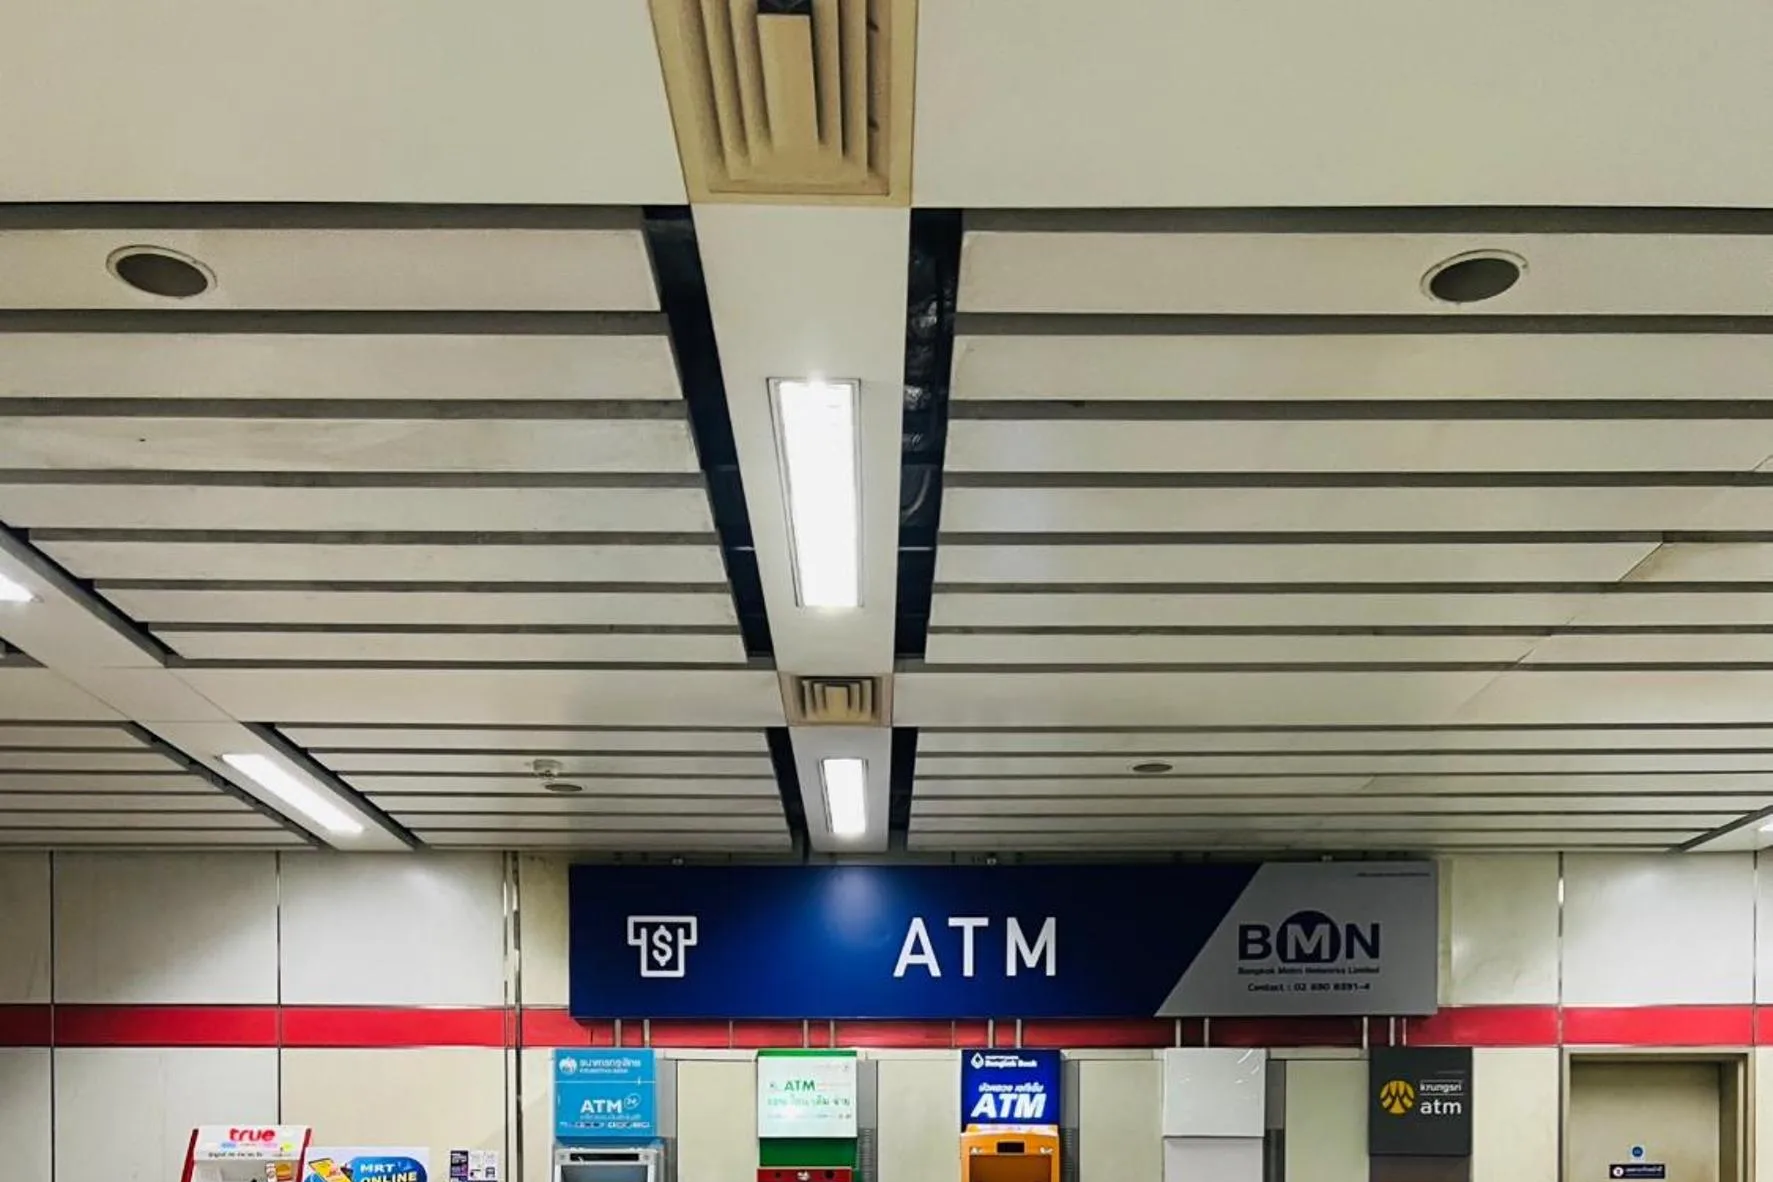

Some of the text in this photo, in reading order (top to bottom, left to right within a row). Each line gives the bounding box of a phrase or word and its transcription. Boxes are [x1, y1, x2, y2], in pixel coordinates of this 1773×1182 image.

[1238, 911, 1380, 963] BMN
[893, 916, 1057, 977] ATM
[1247, 983, 1284, 992] Contact
[784, 1080, 816, 1091] ATM
[1420, 1083, 1462, 1093] krungsri
[580, 1099, 622, 1113] ATM
[970, 1093, 1047, 1118] ATM
[1420, 1099, 1462, 1114] atm
[229, 1128, 275, 1141] true
[360, 1163, 395, 1174] MRT
